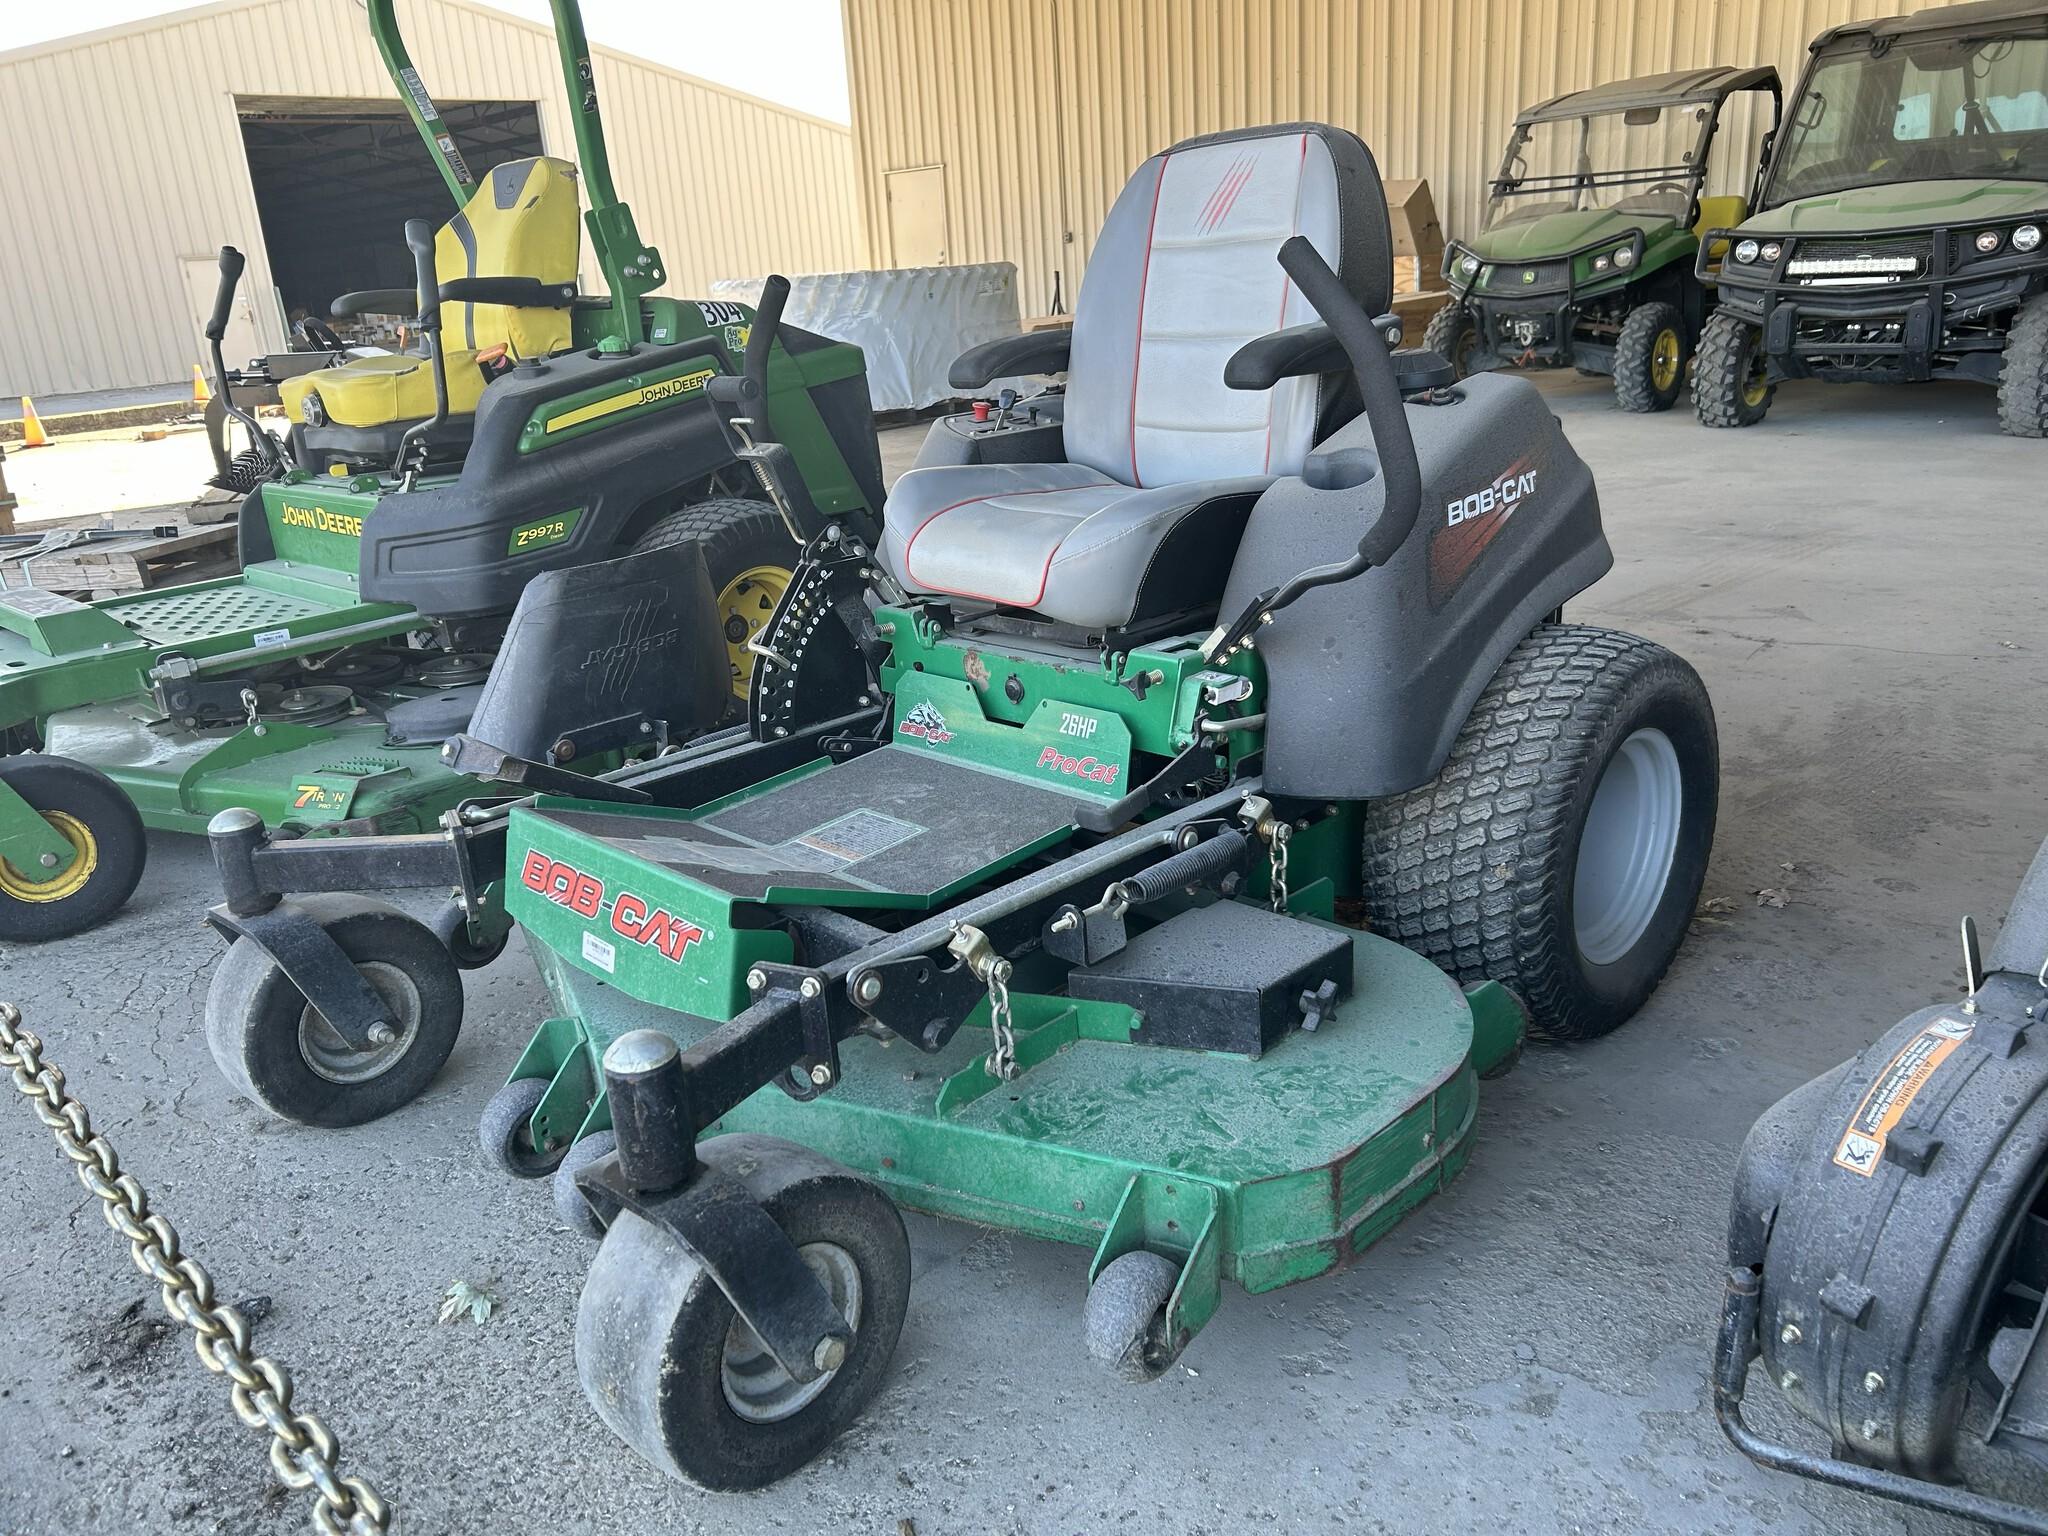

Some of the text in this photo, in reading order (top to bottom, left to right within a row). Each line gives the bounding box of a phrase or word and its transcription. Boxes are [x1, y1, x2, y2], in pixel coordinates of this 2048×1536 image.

[697, 301, 742, 326] 304
[638, 384, 671, 404] JOHN
[1447, 469, 1537, 527] BOB-CAT
[282, 501, 362, 537] JOHN DEERE
[898, 720, 958, 743] BOB-CAT
[1059, 712, 1098, 739] 26HP
[1036, 746, 1120, 784] ProCat
[521, 847, 704, 965] BOB-CAT
[1885, 1078, 1906, 1103] THROWN
[1894, 1065, 1929, 1107] WARNING
[1867, 1103, 1889, 1132] OBJECTS
